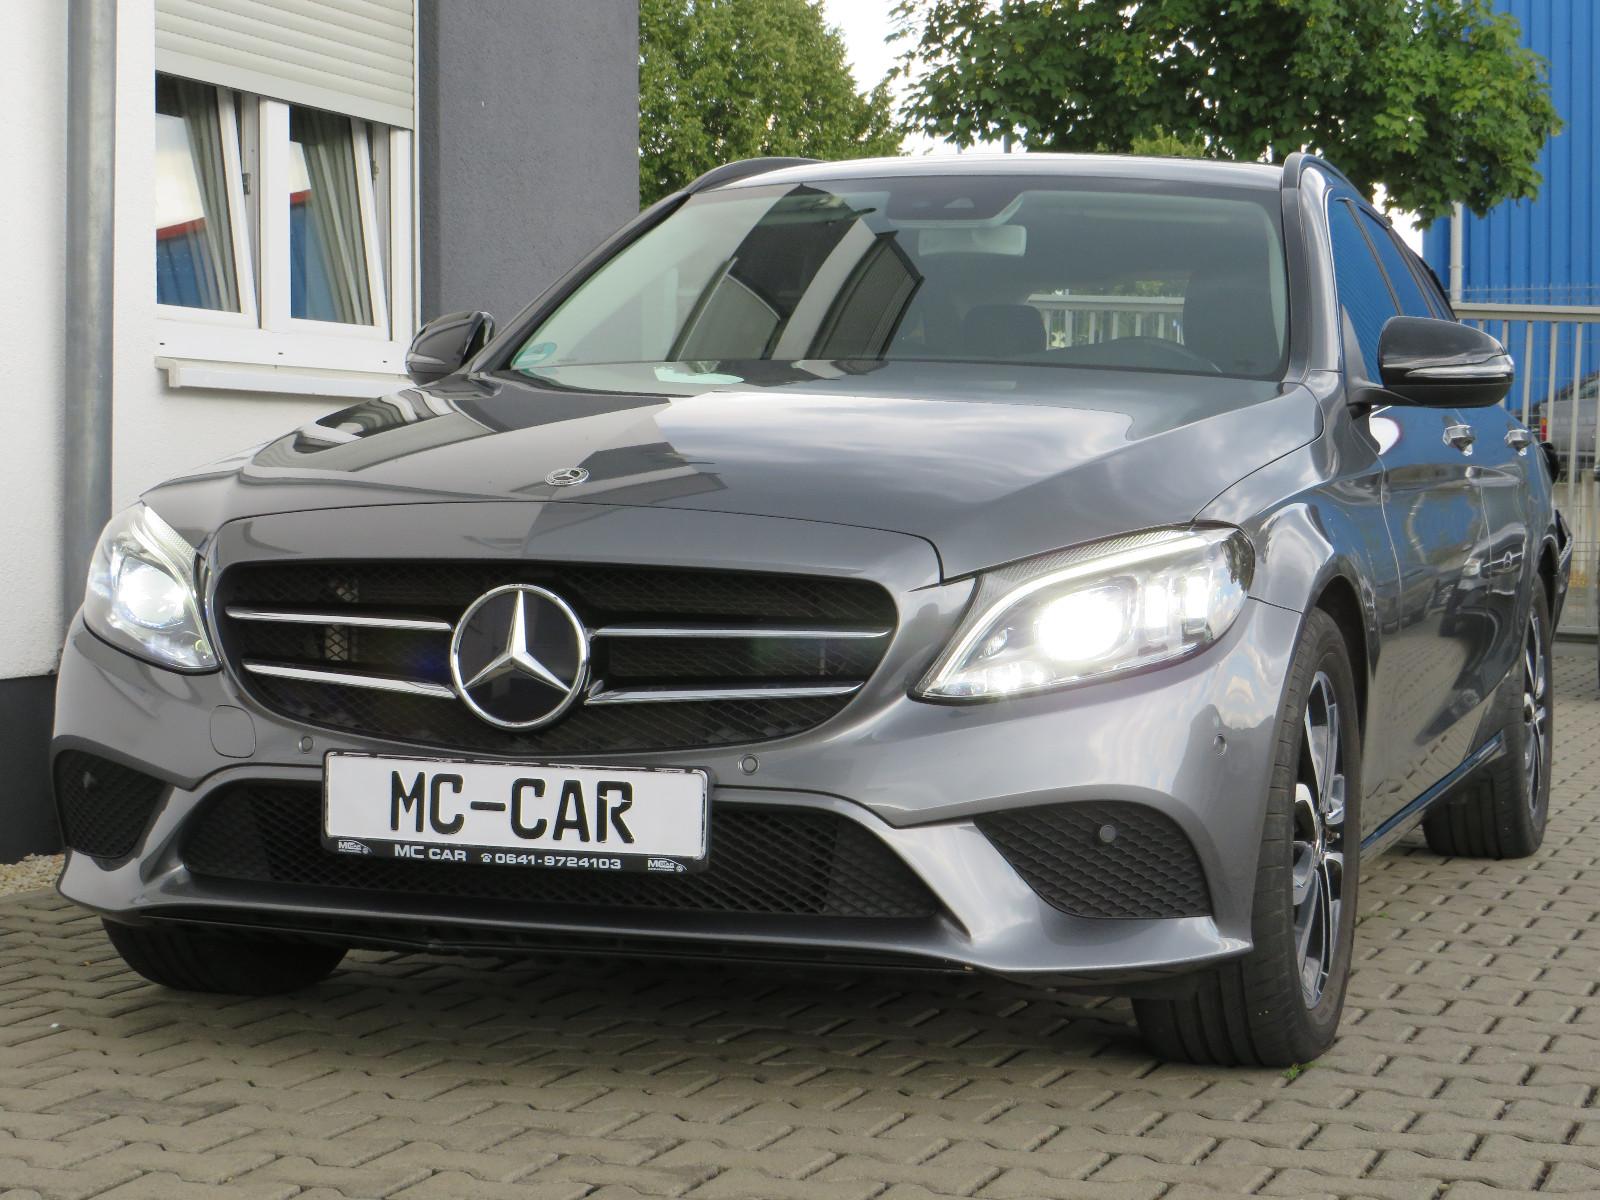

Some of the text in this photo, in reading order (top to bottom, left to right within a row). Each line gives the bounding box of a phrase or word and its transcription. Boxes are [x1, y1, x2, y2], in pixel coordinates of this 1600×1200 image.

[390, 770, 635, 844] MC-CAR
[394, 843, 468, 861] MC CAR
[494, 853, 622, 870] 0641-9724103
